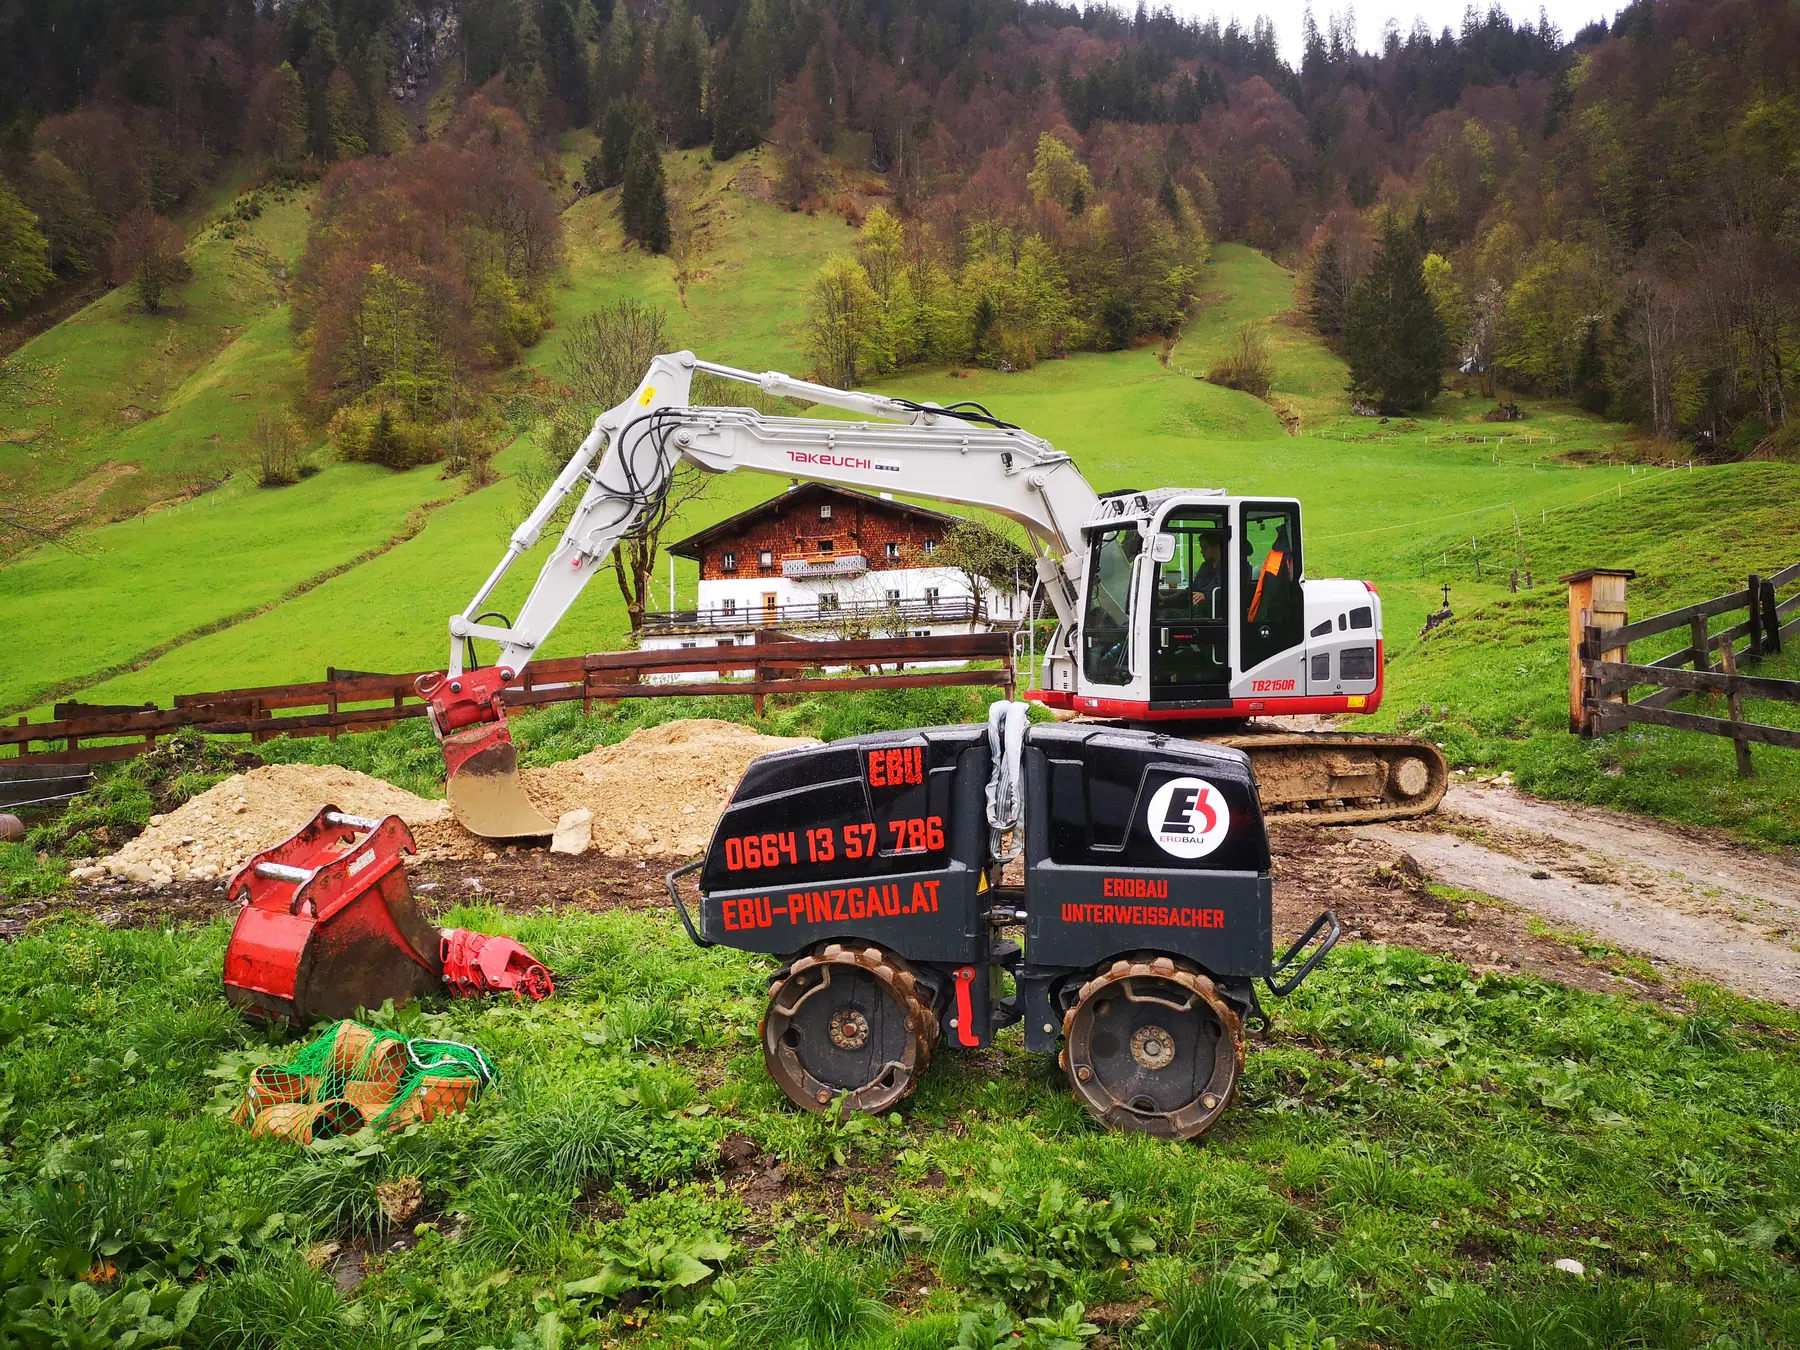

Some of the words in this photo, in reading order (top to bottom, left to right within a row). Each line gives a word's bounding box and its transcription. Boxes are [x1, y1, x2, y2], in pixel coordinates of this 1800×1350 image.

[1252, 679, 1295, 692] TB2150R
[868, 747, 923, 787] EBU
[725, 831, 797, 871] 0664
[806, 827, 835, 863] 13
[844, 823, 877, 859] 57
[889, 816, 945, 854] 786
[1159, 835, 1204, 844] ERDBAU
[1103, 878, 1168, 899] ERDBAU
[722, 880, 941, 931] EBU-PINZGAU.AT
[1061, 903, 1224, 928] UNTERWEISSACHER
